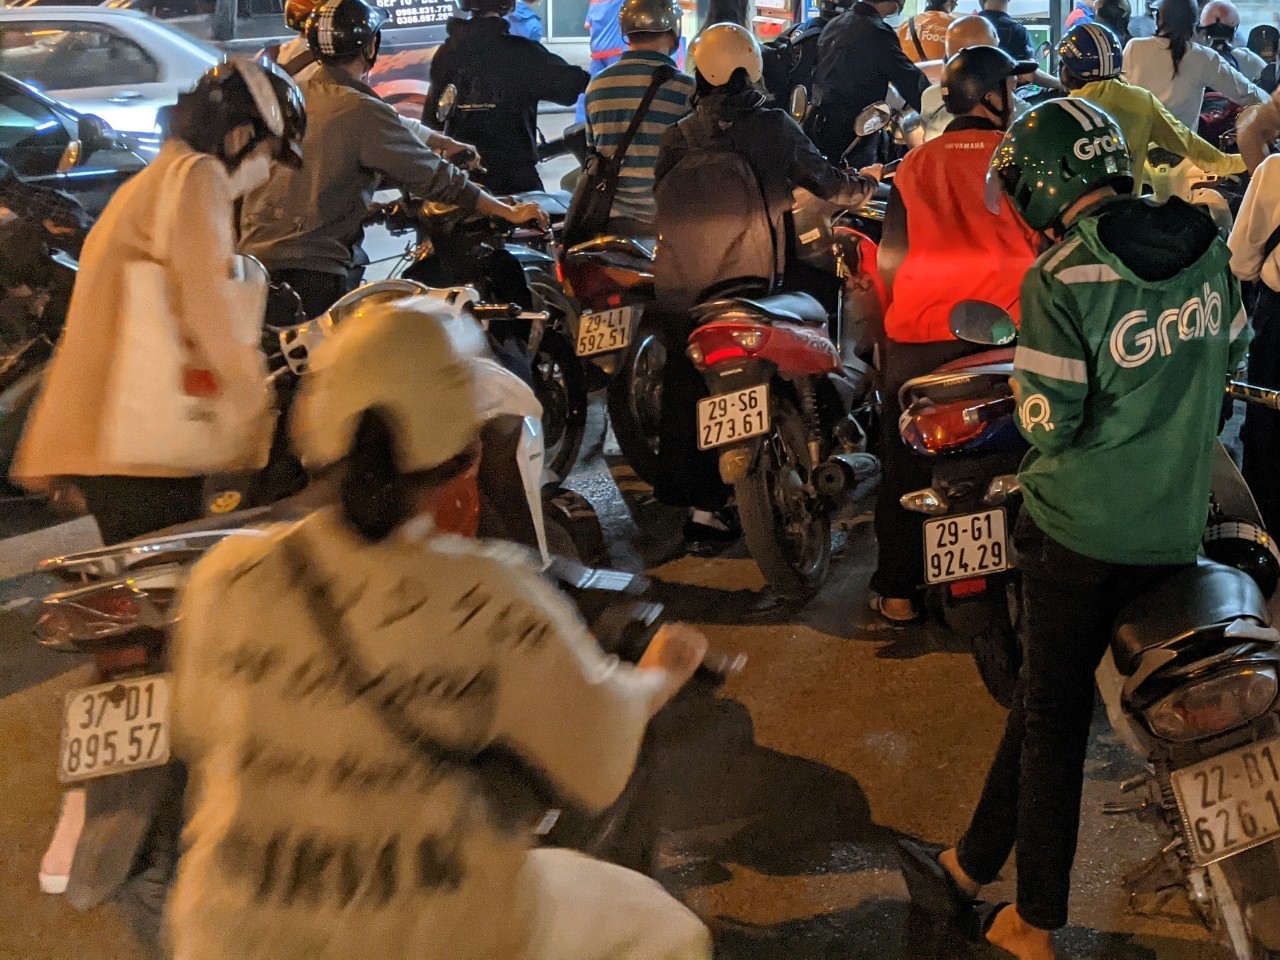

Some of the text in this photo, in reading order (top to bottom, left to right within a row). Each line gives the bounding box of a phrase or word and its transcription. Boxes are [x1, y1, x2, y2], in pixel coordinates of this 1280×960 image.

[954, 142, 984, 150] YAMAHA
[584, 309, 624, 334] 29-L1
[1109, 282, 1222, 368] Grab
[579, 328, 626, 354] 592.51
[708, 390, 758, 421] 29-S6
[702, 410, 764, 446] 273.61
[936, 514, 992, 548] 29-G1
[930, 541, 1002, 578] 924.29
[80, 682, 154, 730] 37D1
[67, 722, 162, 773] 895.57
